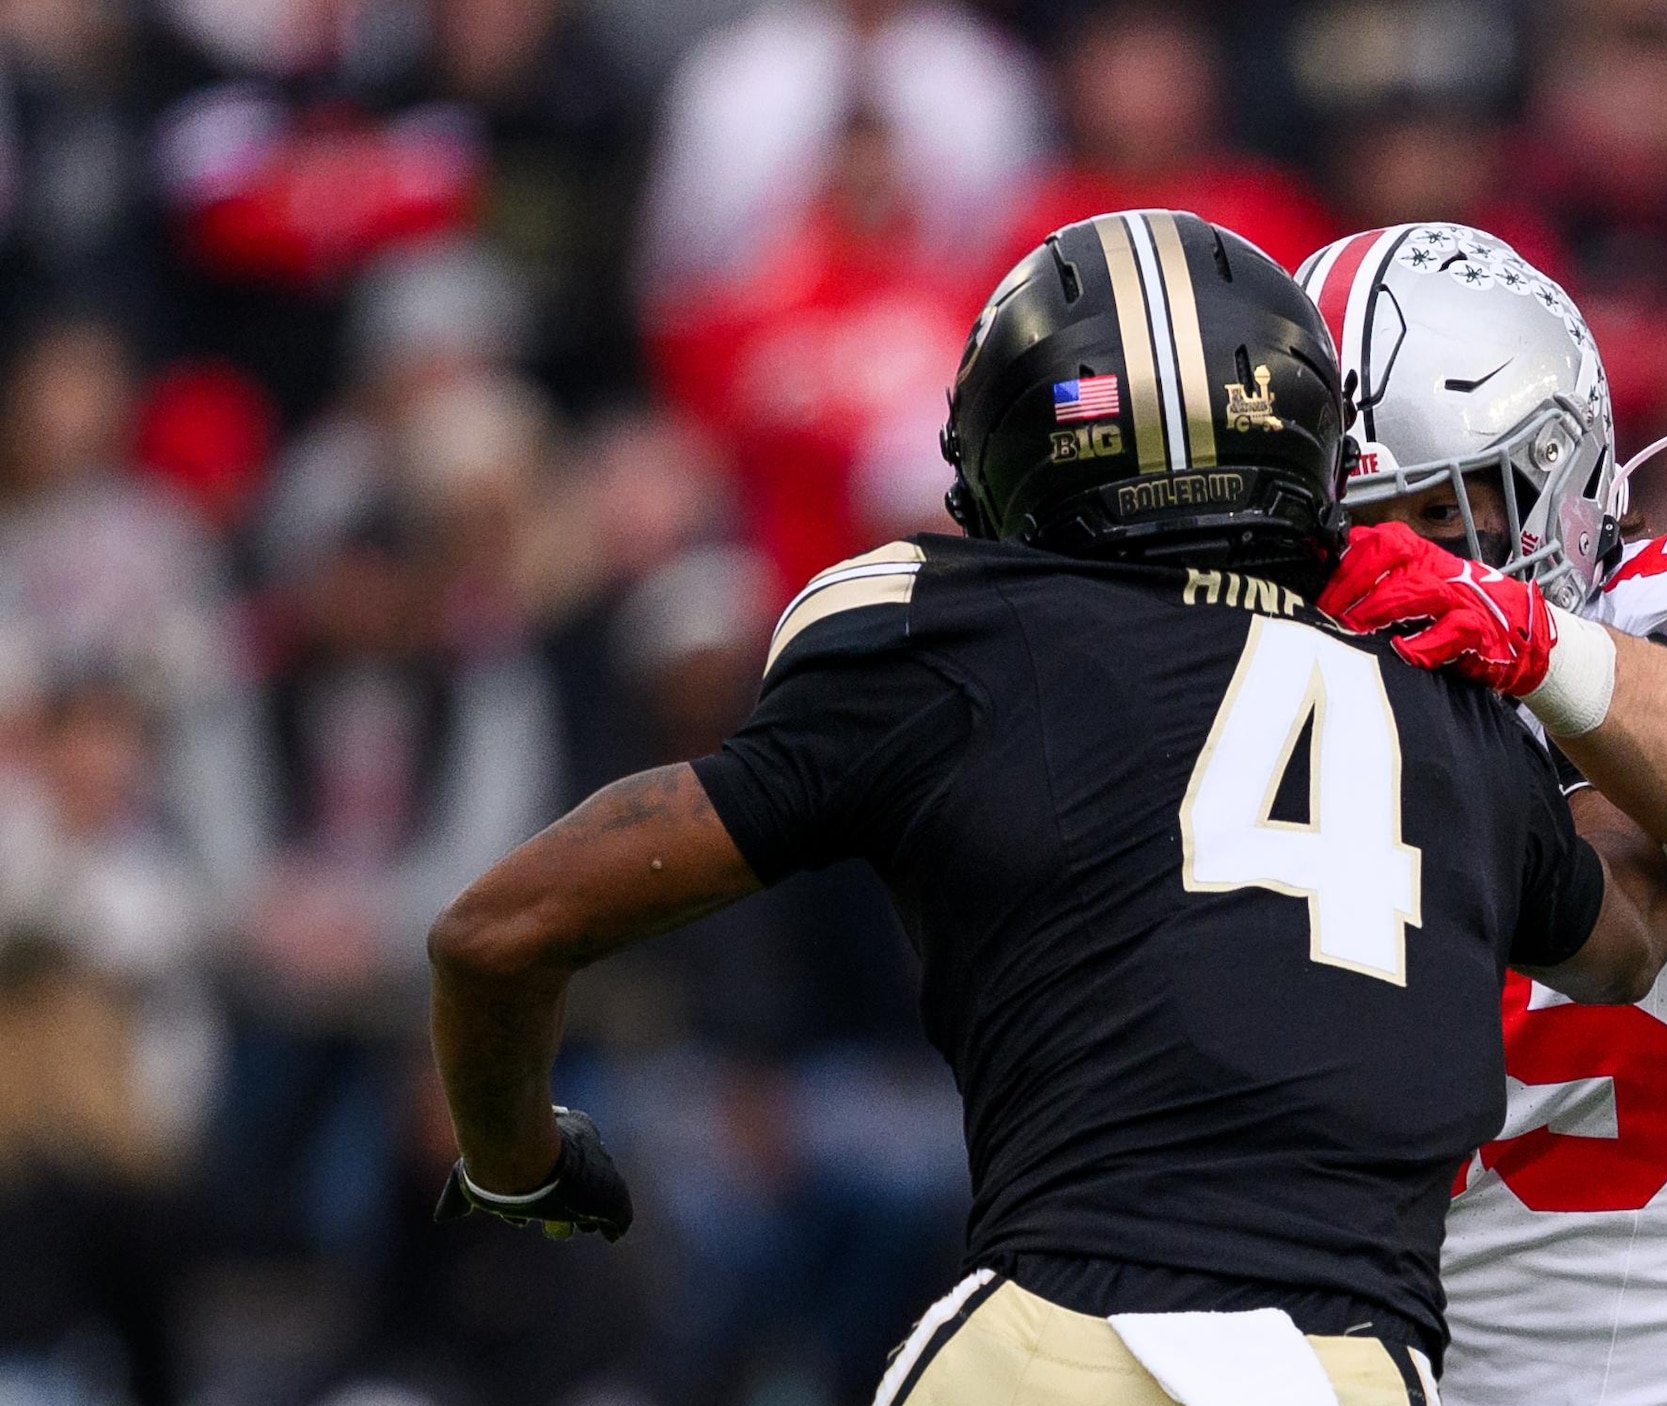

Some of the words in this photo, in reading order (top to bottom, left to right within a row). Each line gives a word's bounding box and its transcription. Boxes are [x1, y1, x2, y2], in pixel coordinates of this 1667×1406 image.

[1118, 475, 1208, 516] BOILER
[1208, 473, 1243, 503] UP
[1179, 613, 1422, 987] 4
